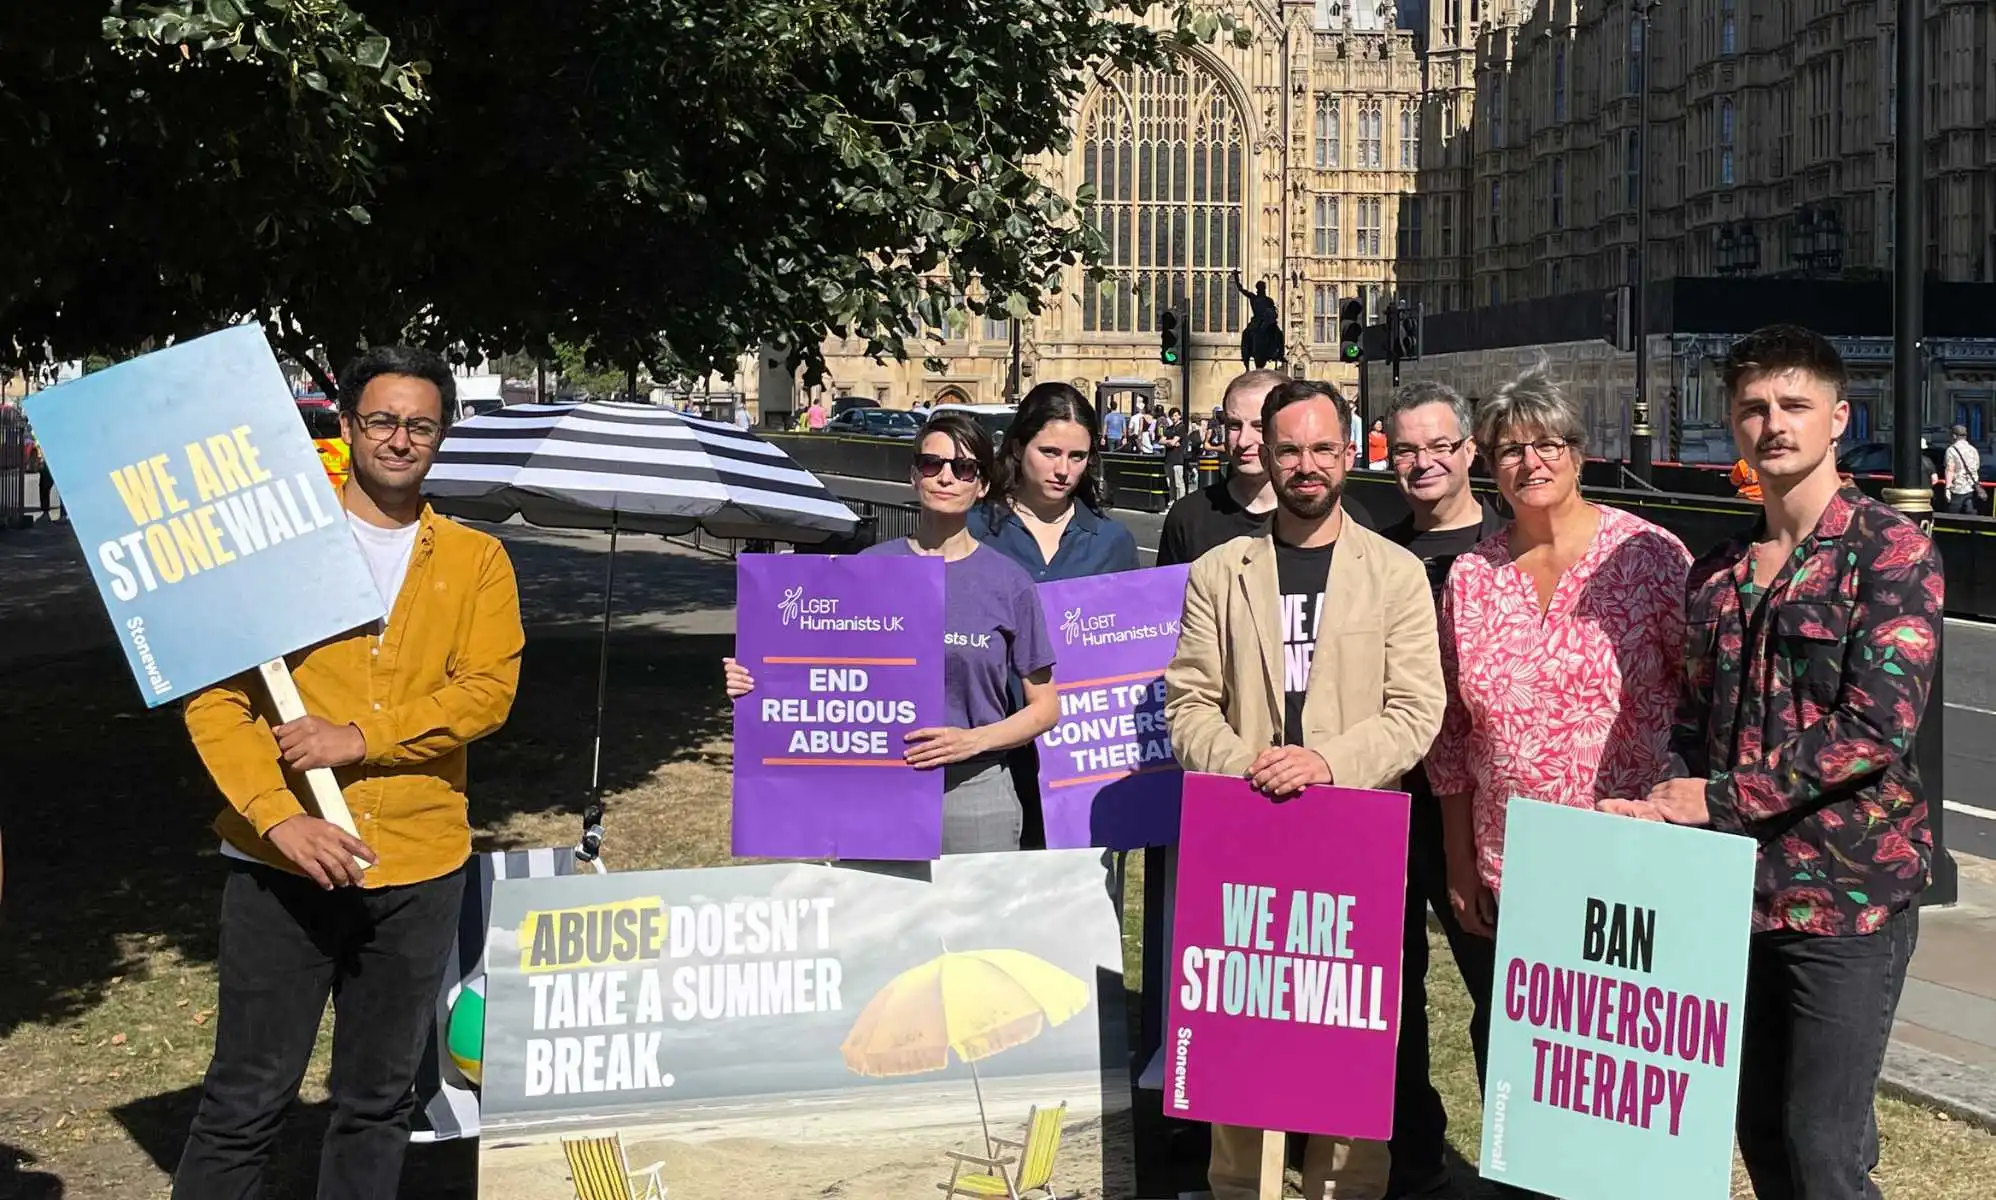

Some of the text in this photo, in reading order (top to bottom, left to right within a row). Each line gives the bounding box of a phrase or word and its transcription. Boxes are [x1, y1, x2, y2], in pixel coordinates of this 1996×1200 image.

[110, 425, 272, 527] WE ARE
[98, 472, 335, 602] STONEWALL
[800, 599, 839, 614] LGBT
[800, 615, 904, 632] Humanists UK
[970, 633, 991, 648] UK
[1081, 614, 1116, 632] LGBT
[1082, 619, 1179, 646] Humanists UK
[126, 616, 172, 695] Stonewall
[809, 668, 869, 692] END
[762, 698, 917, 724] RELIGIOUS
[1042, 709, 1167, 747] CONVERS
[1058, 688, 1109, 716] IME
[1112, 684, 1148, 709] TO
[788, 730, 889, 754] ABUSE
[530, 899, 835, 968] ABUSE DOESN'T
[1221, 882, 1356, 959] WE ARE
[1583, 896, 1656, 973] BAN
[529, 958, 843, 1030] TAKE A SUMMER
[1180, 945, 1387, 1031] STONEWALL
[1505, 958, 1728, 1068] CONVERSION
[525, 1032, 675, 1096] BREAK.
[1173, 1027, 1193, 1110] Stonewall
[1532, 1038, 1690, 1136] THERAPY
[1490, 1080, 1512, 1172] Stonewall
